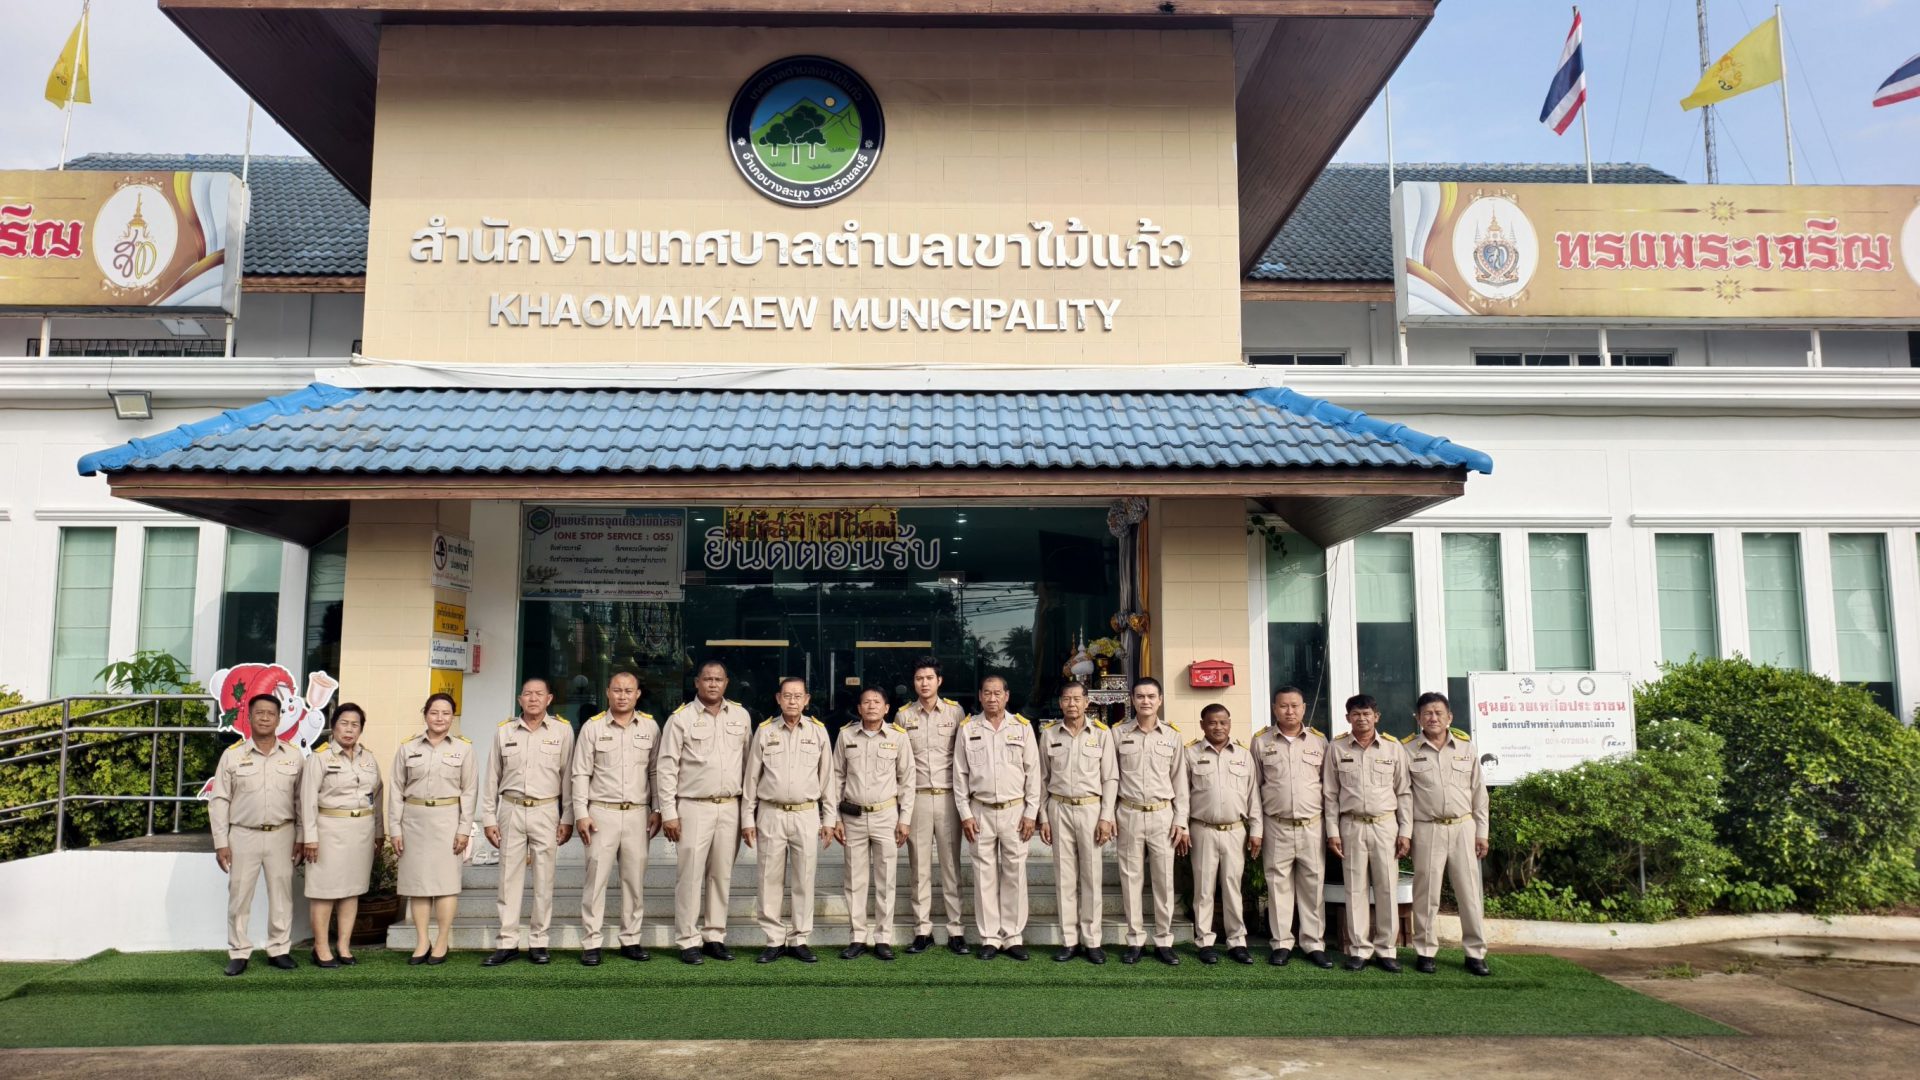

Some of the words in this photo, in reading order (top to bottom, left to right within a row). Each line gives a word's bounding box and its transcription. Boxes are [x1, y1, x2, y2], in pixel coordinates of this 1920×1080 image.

[742, 151, 810, 201] อำเภอบางละมุง
[813, 153, 869, 199] จังหวัดชลบุรี
[410, 215, 1191, 268] สำนักงานเทศบาลตำบลเขาไม้แก้ว
[1555, 216, 1895, 273] ทรงพระเจริญ
[489, 293, 818, 330] KHAOMAIKAEW
[833, 297, 1122, 332] MUNICIPALITY
[554, 531, 577, 541] (ONE
[580, 531, 603, 541] STOP
[607, 531, 642, 541] SERVICE
[653, 532, 674, 542] OSS)
[704, 524, 941, 570] ยินดตอนรับ
